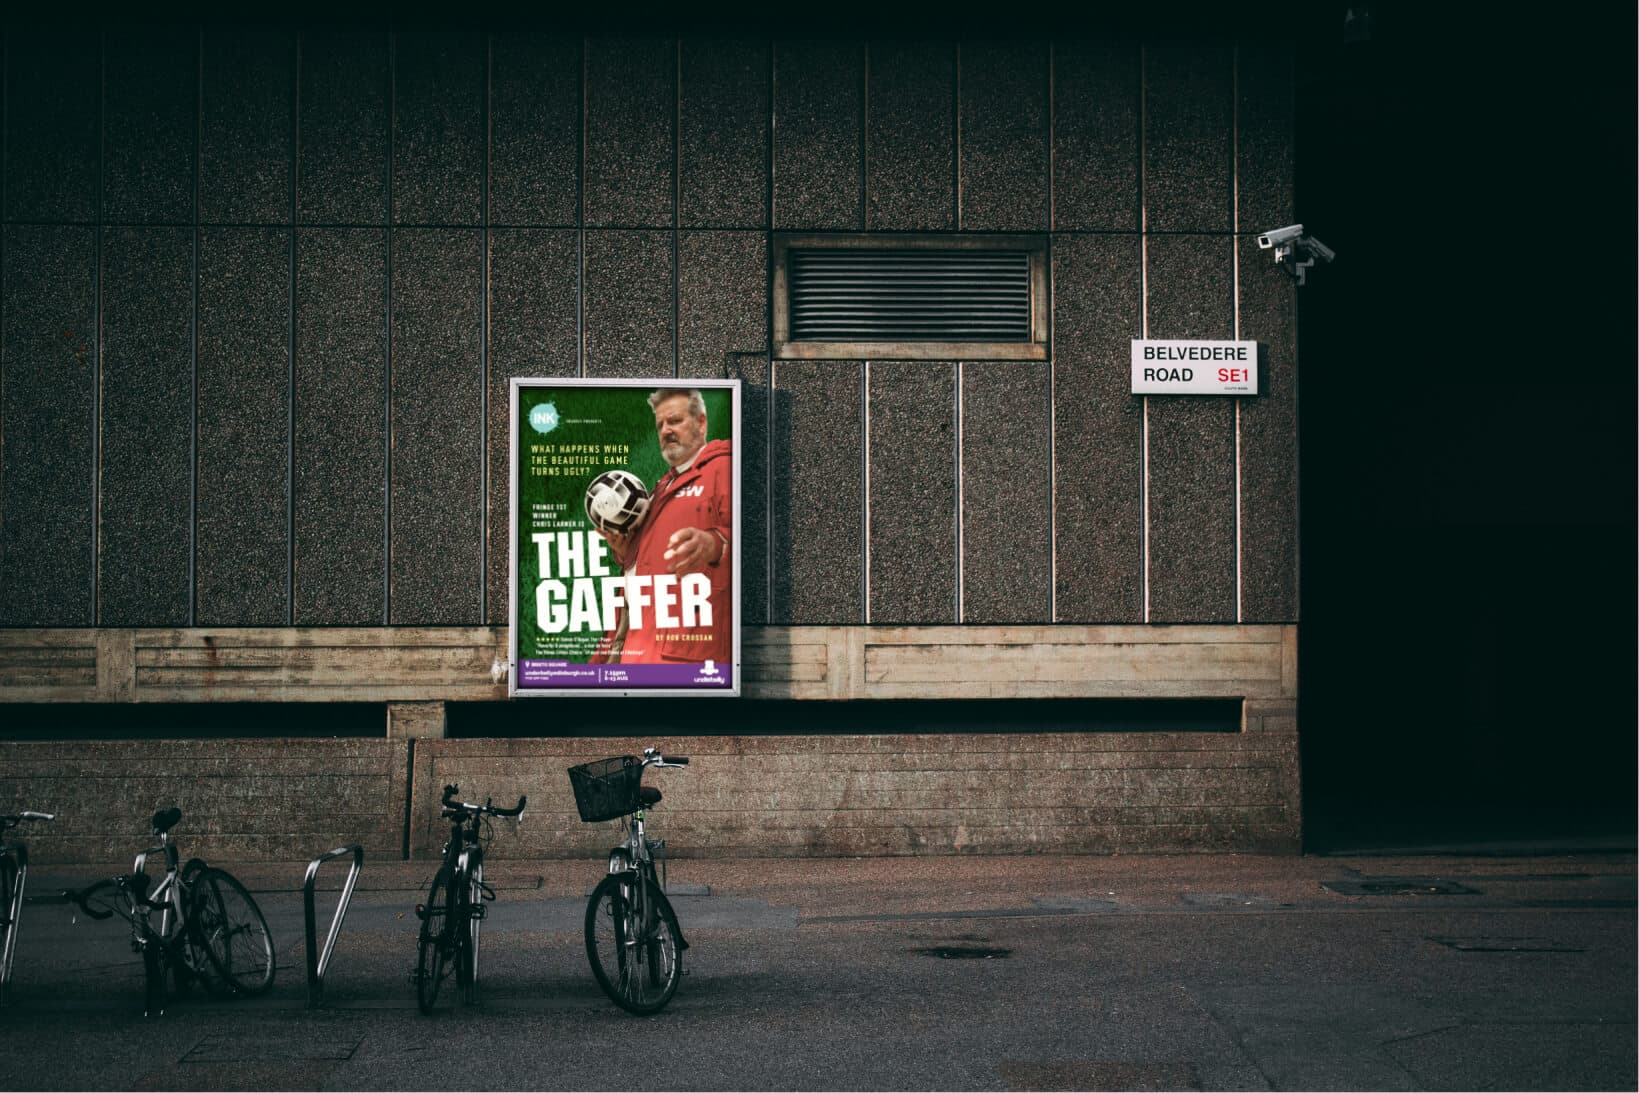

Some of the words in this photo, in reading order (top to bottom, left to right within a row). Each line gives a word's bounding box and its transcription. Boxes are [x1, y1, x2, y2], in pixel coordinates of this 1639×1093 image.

[1144, 347, 1248, 360] BELVEDERE
[1144, 368, 1193, 382] ROAD
[1218, 368, 1248, 382] SE1
[534, 412, 555, 425] INK
[531, 445, 555, 453] WHAT
[560, 445, 600, 453] HAPPENS
[604, 445, 629, 453] WHEN
[531, 456, 548, 465] THE
[552, 456, 600, 465] BEAUTIFUL
[604, 456, 628, 465] GAME
[531, 467, 560, 476] TURNS
[564, 467, 590, 476] UGLY?
[532, 531, 609, 579] THE
[536, 573, 713, 633] GAFFER
